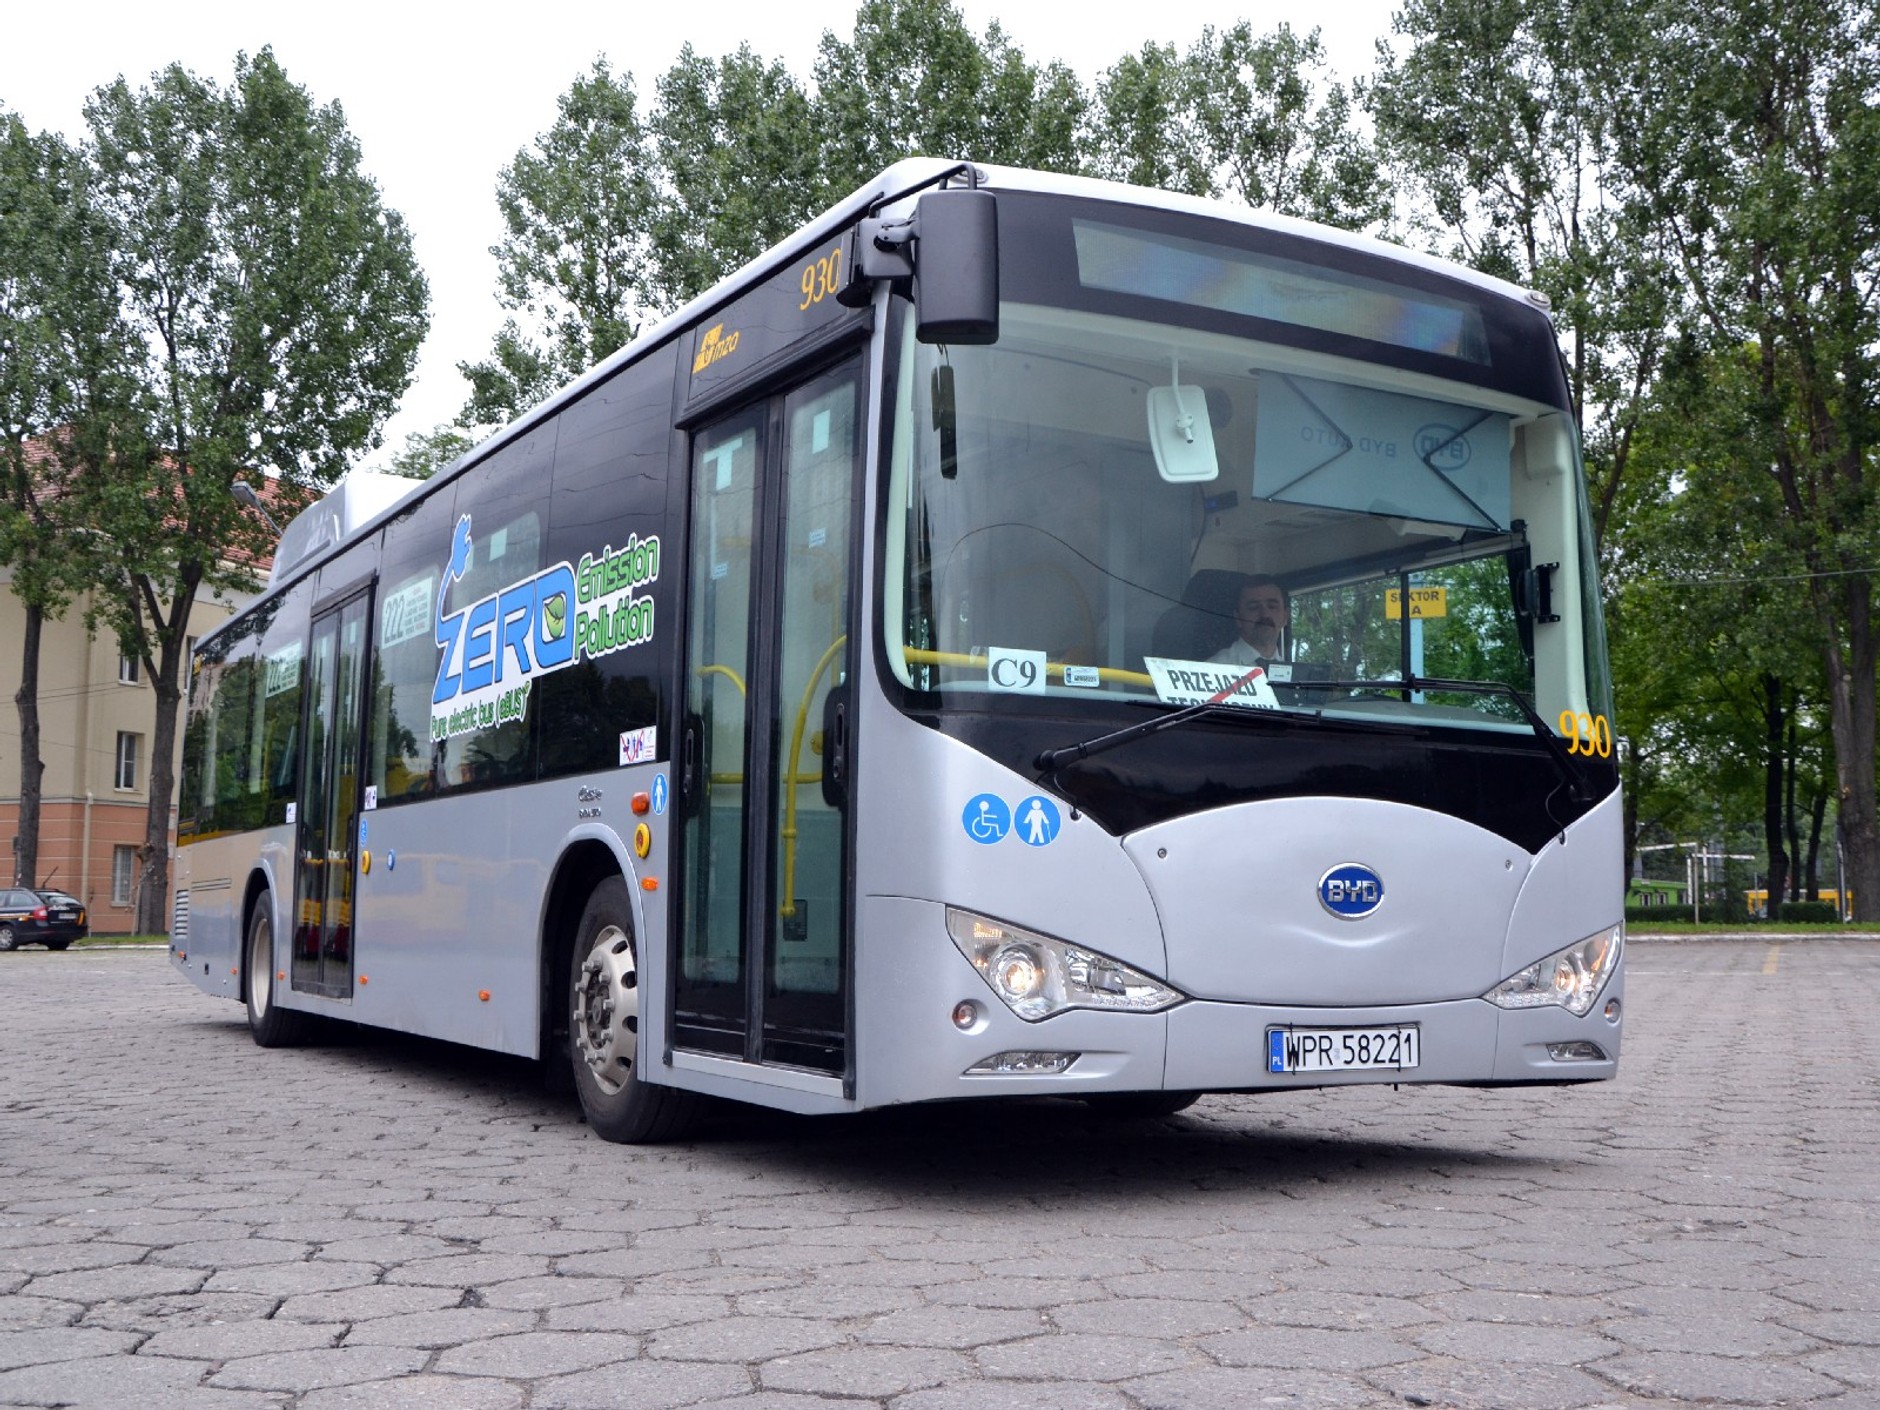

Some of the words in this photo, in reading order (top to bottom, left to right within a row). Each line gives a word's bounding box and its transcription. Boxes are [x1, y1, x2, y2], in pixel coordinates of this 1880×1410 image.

[799, 247, 842, 311] 930
[577, 535, 659, 603] Emission
[1390, 591, 1440, 603] SKTOR
[1411, 605, 1422, 615] A
[432, 565, 576, 704] ZERO
[575, 597, 654, 661] Pollution
[991, 658, 1037, 689] C9
[1167, 669, 1258, 697] PRZEJAZD
[431, 714, 448, 741] Pure
[448, 702, 477, 735] electric
[479, 699, 494, 727] bus
[1558, 709, 1612, 759] 930
[1327, 879, 1378, 903] BYD
[1286, 1034, 1333, 1068] WPR
[1342, 1032, 1413, 1066] 58221
